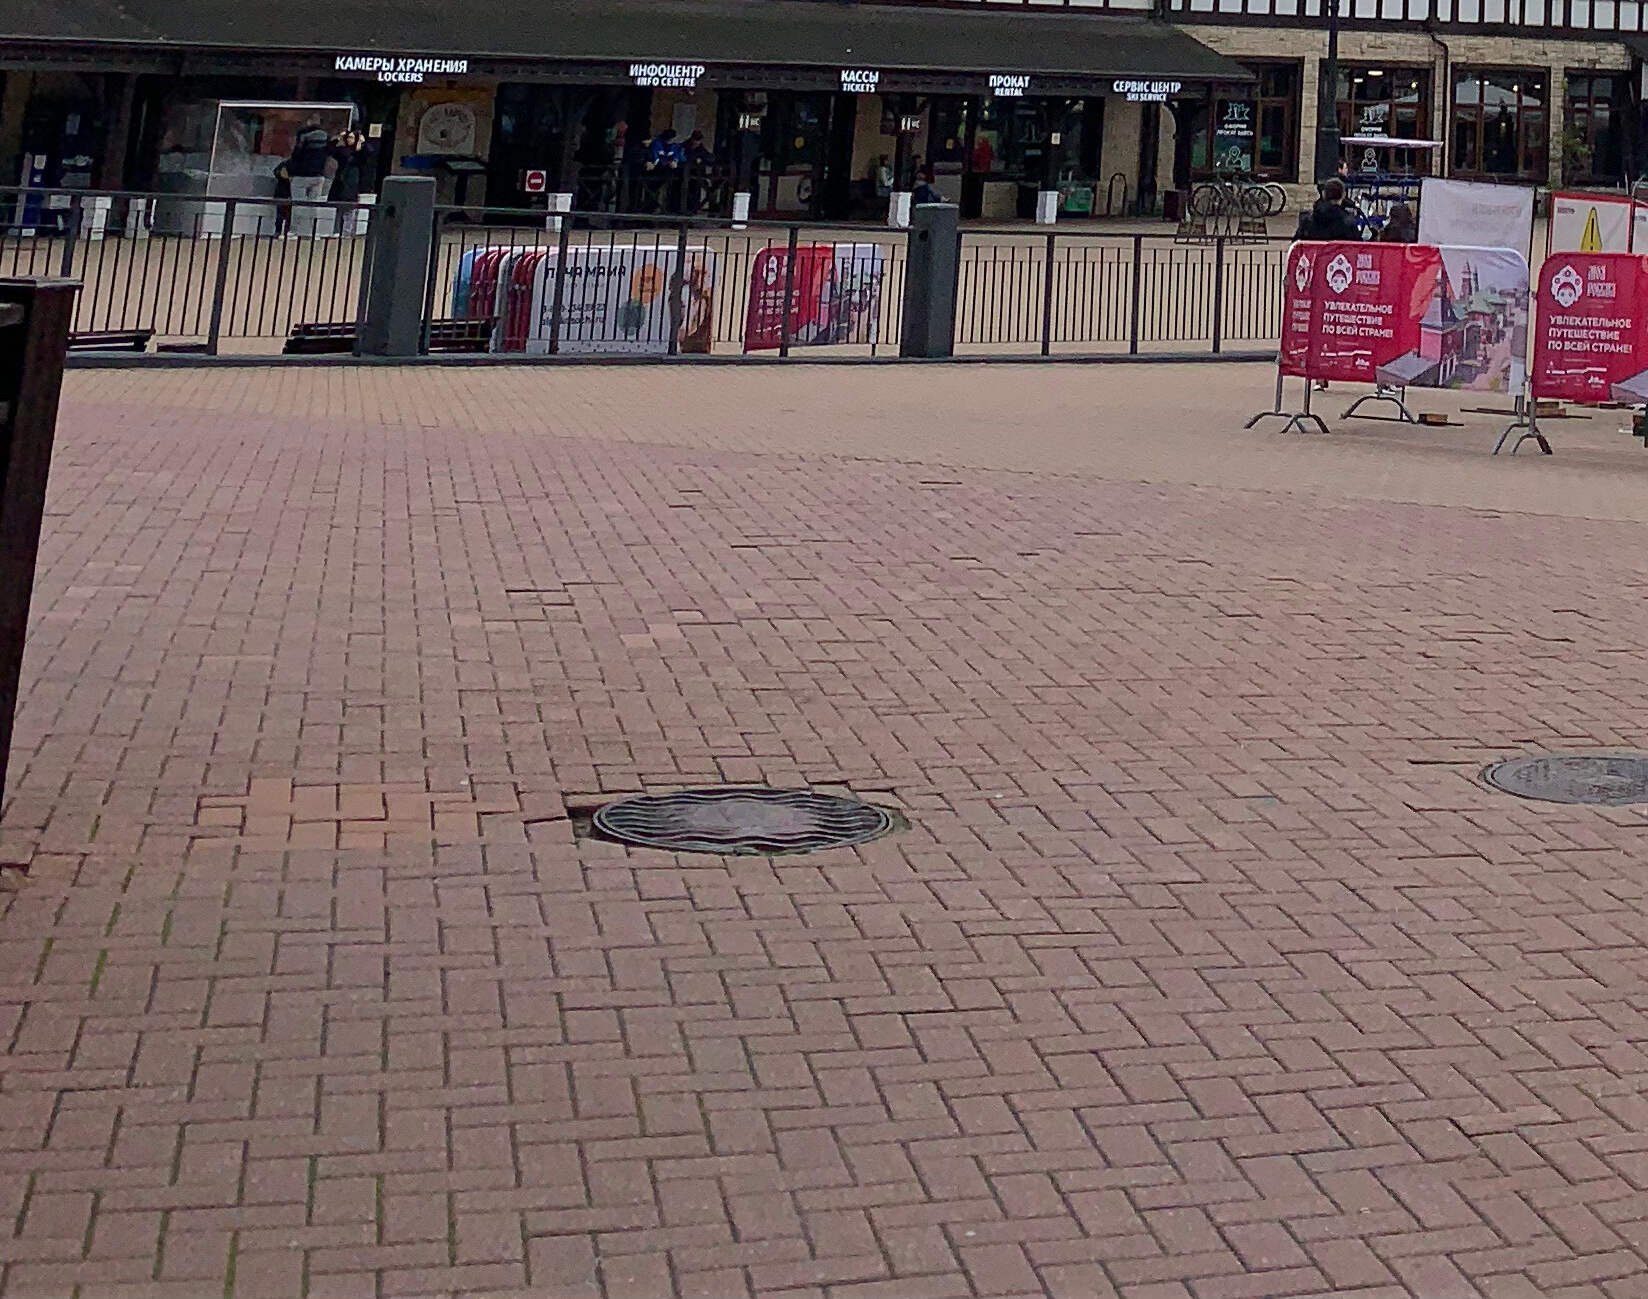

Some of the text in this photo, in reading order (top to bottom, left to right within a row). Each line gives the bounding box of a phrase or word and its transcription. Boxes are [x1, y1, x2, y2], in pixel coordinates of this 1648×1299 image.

[335, 56, 468, 73] КАМЕРЫ ХРАНЕНИЯ
[629, 64, 705, 78] ИНФОЦЕНТР
[377, 72, 423, 82] LOCKERS
[637, 77, 696, 87] INFO CENTRE
[841, 70, 879, 83] КАССЫ
[989, 75, 1030, 88] ПРОКАТ
[843, 83, 875, 92] TICKETS
[994, 88, 1023, 96] RENTAL
[1113, 80, 1181, 93] СЕРВИС ЦЕНТР
[1549, 315, 1631, 328] УВЛЕКАТЕЛЬНОЕ
[1322, 325, 1335, 334] ПО
[1548, 327, 1620, 340] ПУТЕШЕСТВИЕ
[1548, 340, 1633, 354] ПО ВСЕЙ СТРАНЕ!
